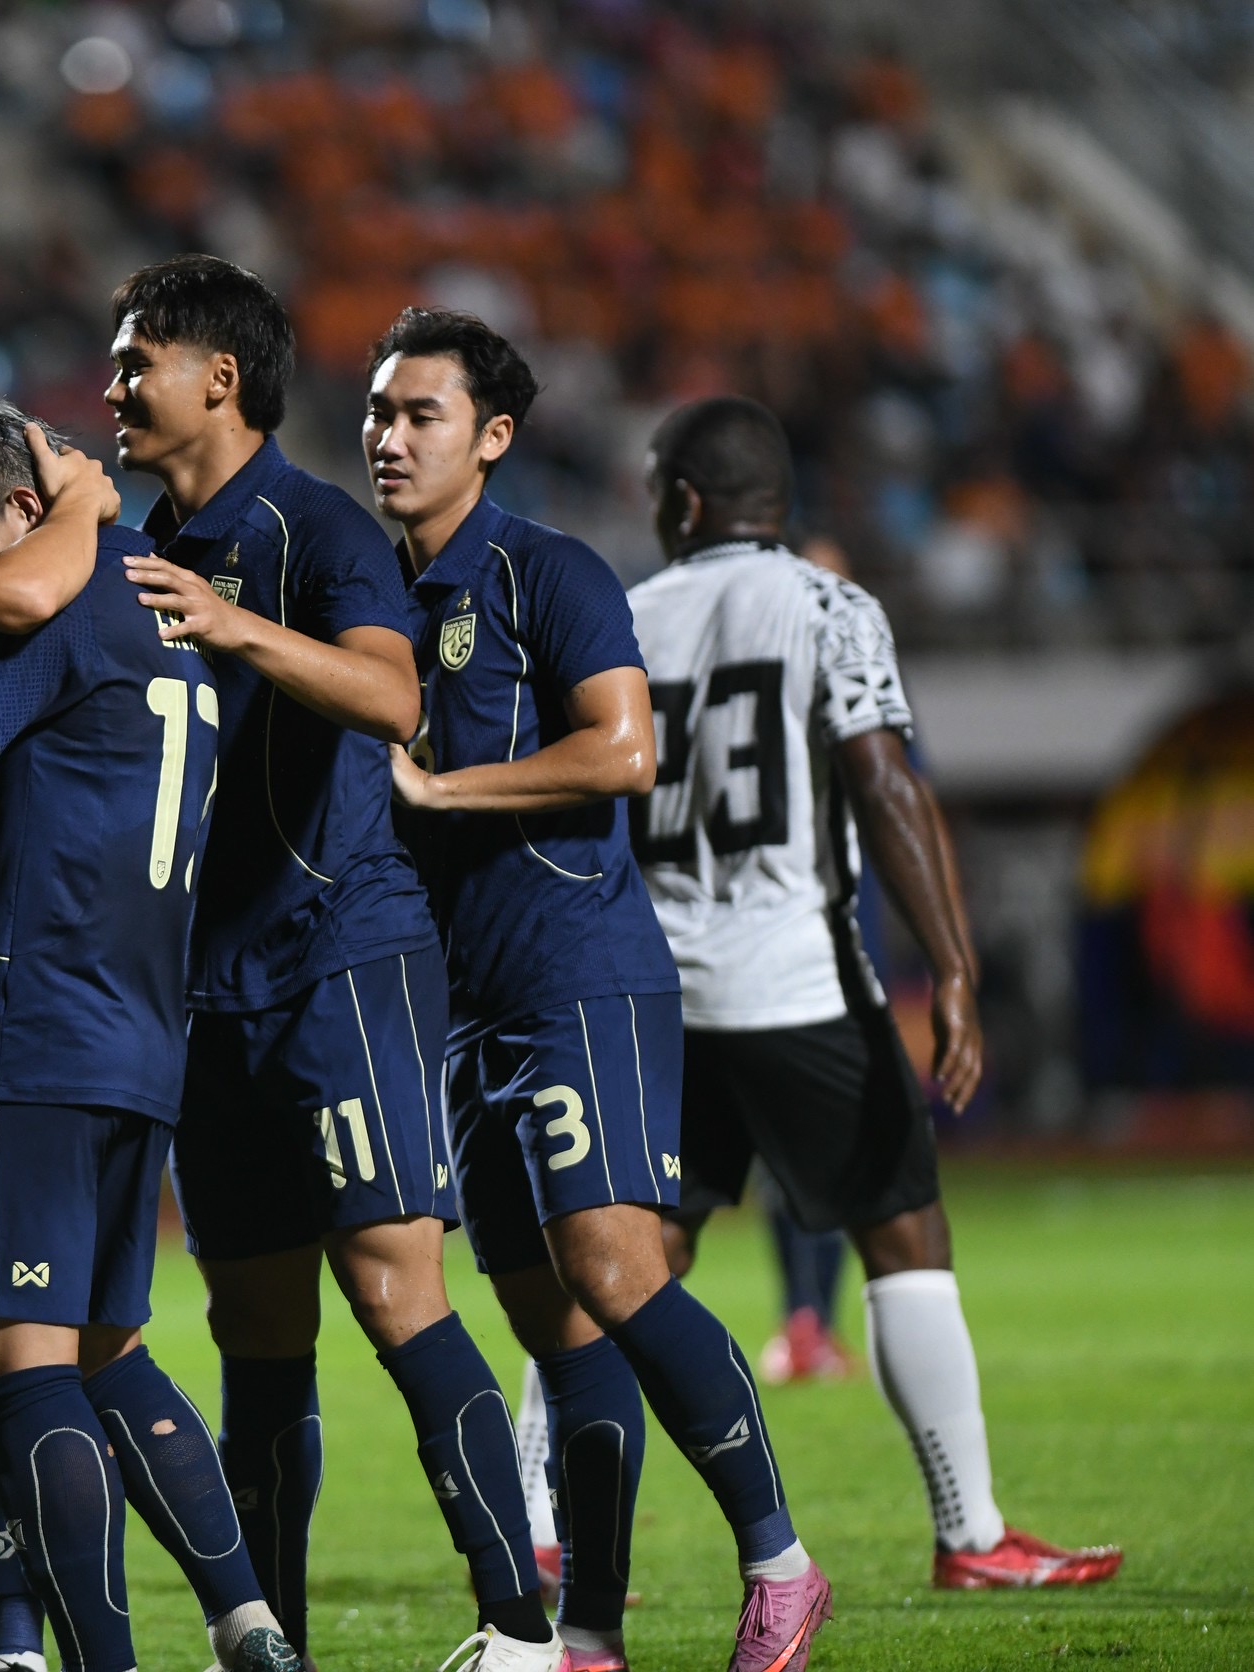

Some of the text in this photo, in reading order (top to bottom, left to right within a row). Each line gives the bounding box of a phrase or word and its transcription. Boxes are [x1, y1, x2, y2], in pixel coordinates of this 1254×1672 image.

[627, 658, 789, 864] 23
[313, 1097, 376, 1189] 11
[532, 1084, 591, 1171] 3
